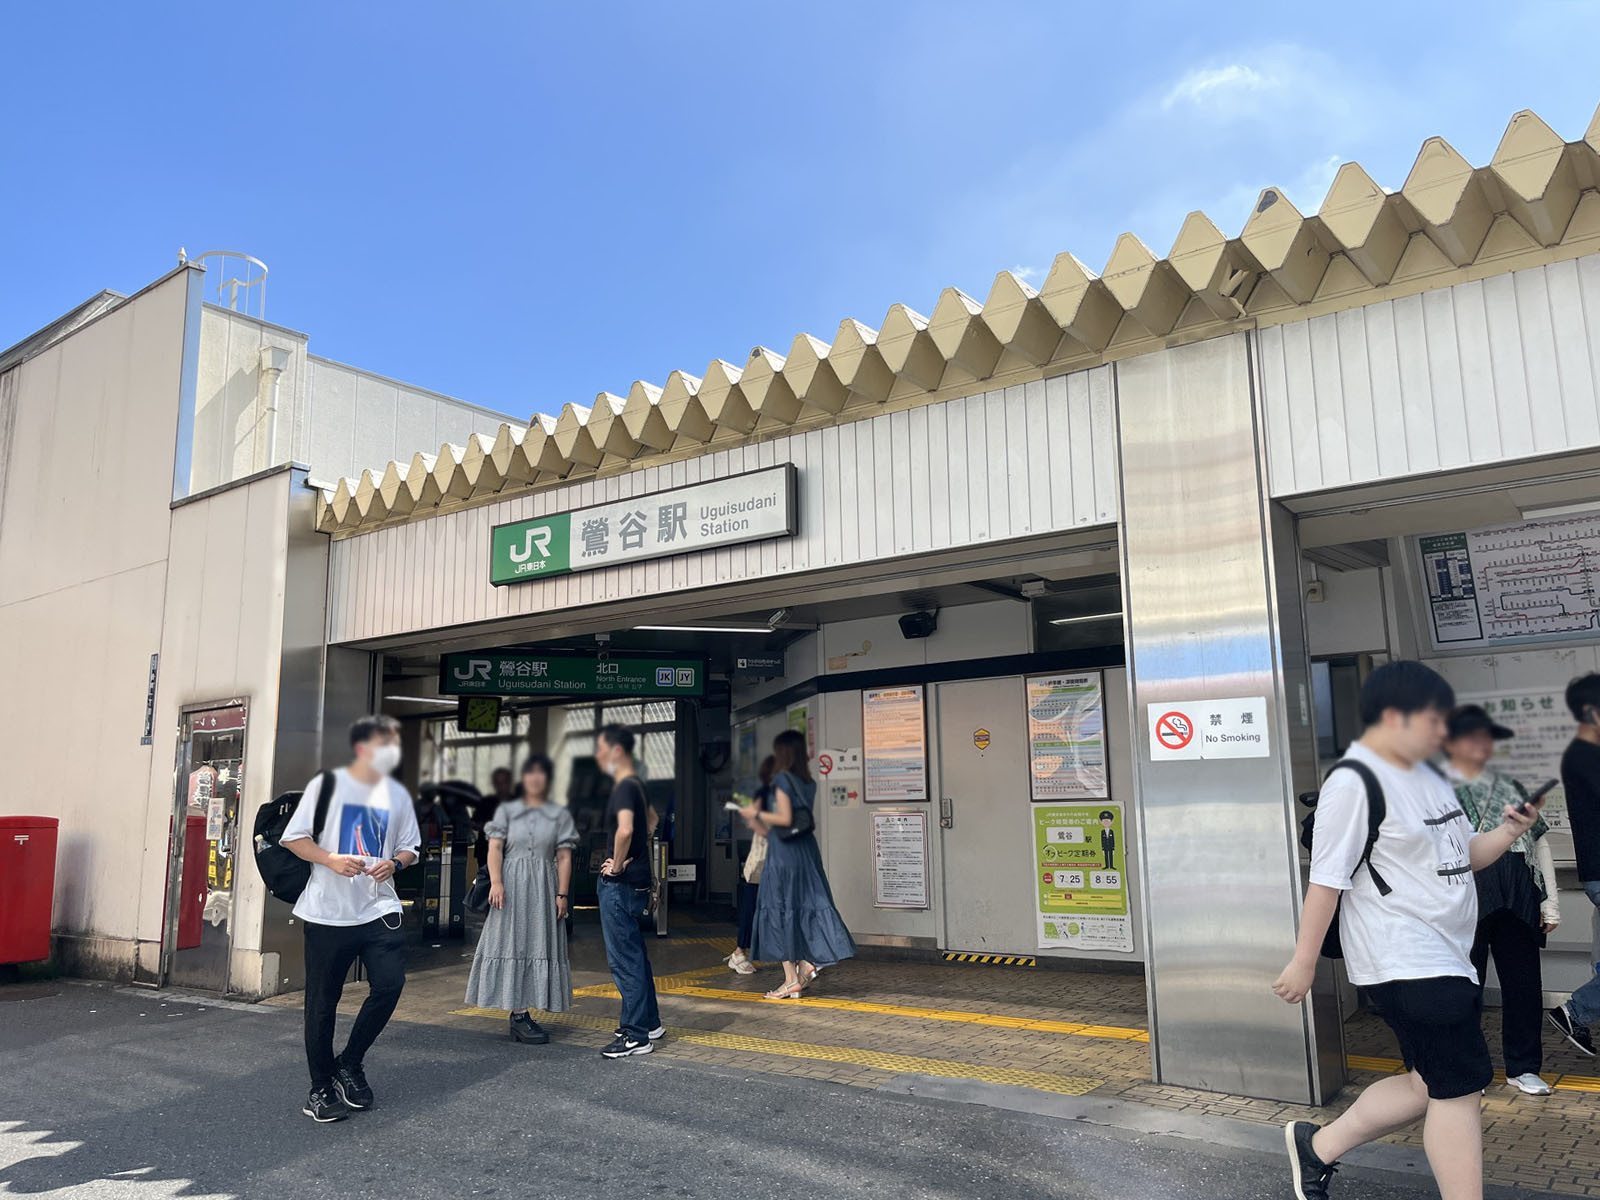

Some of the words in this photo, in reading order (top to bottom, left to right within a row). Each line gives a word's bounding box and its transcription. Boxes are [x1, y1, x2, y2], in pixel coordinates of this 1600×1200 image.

[700, 493, 777, 522] Uguisudani
[581, 501, 688, 558] 鶯谷駅
[700, 518, 749, 537] Station
[510, 525, 552, 563] JR
[514, 560, 547, 574] JR東日本
[453, 659, 492, 680] JR
[499, 660, 548, 677] 鶯谷駅
[596, 662, 619, 674] 北口
[660, 671, 671, 681] JK
[680, 671, 690, 681] JY
[498, 679, 552, 690] Uguisudani
[553, 679, 586, 689] Station
[1209, 712, 1254, 727] 禁煙
[1205, 735, 1218, 743] No
[1220, 733, 1261, 743] Smoking
